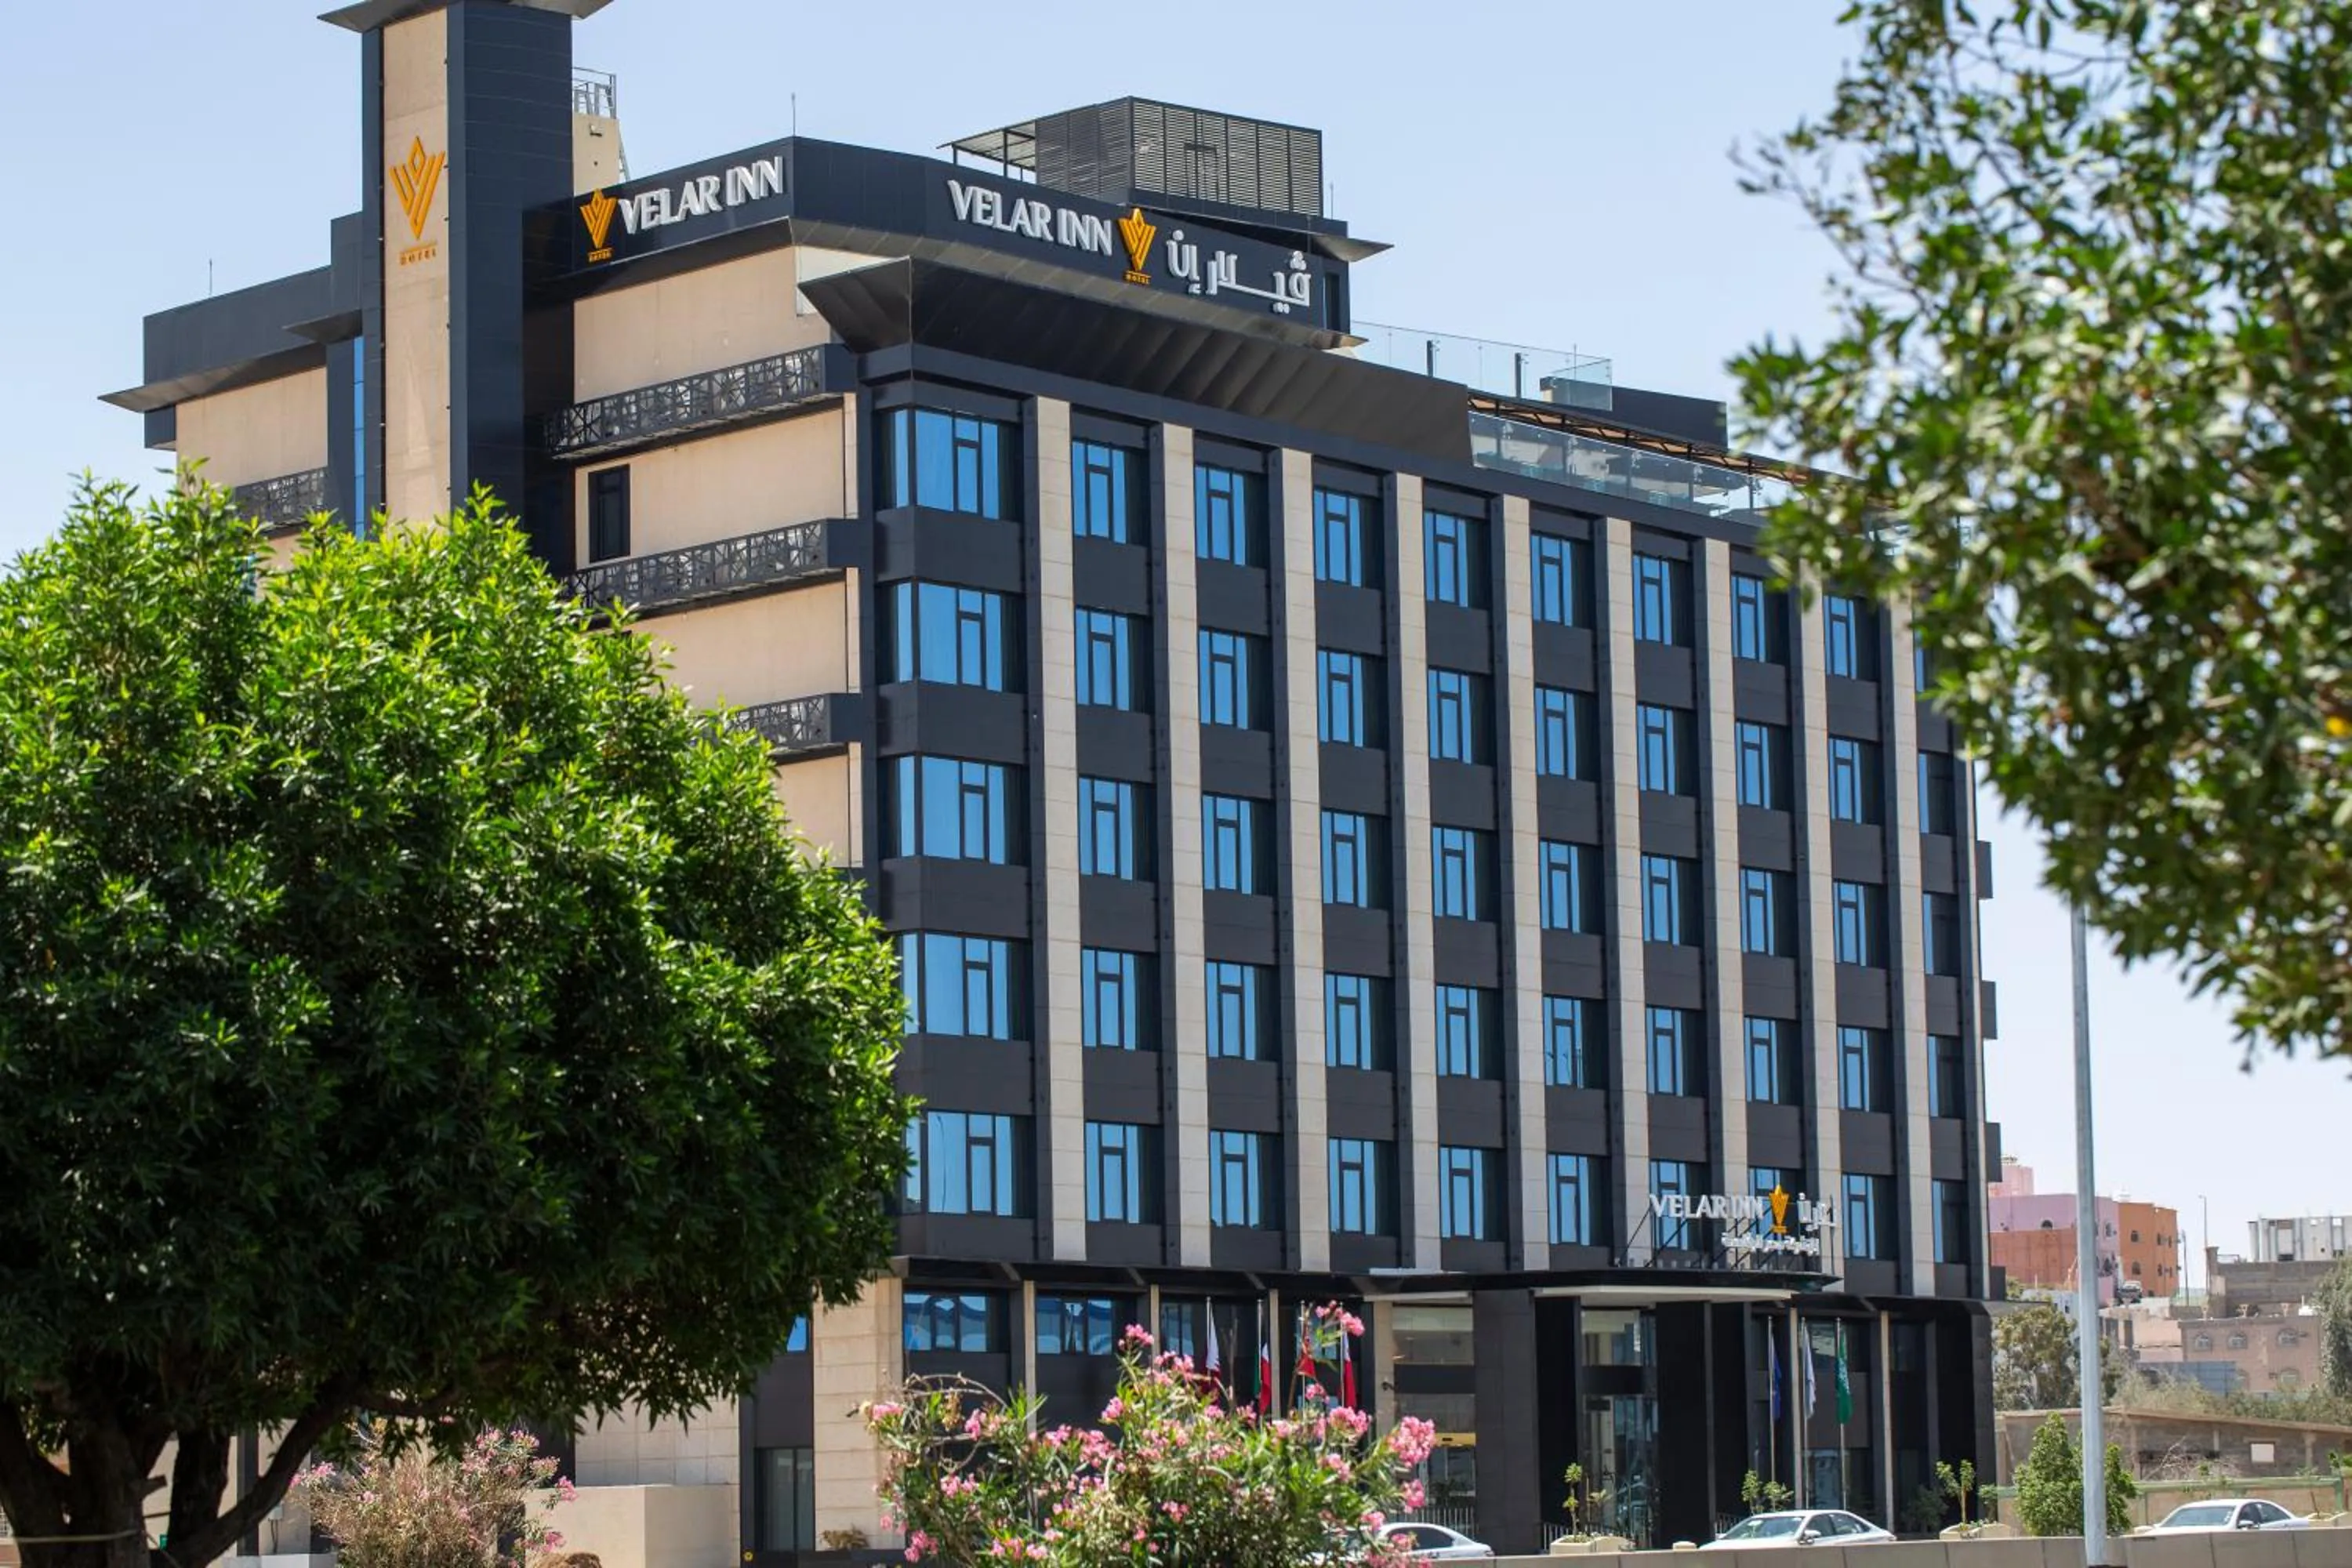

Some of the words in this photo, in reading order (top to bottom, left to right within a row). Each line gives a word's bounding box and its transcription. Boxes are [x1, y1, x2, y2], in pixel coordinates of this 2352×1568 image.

[617, 176, 723, 234] VELAR
[726, 156, 782, 206] INN
[947, 180, 1054, 241] VELAR
[1057, 208, 1112, 256] INN
[1650, 1194, 1727, 1218] VELAR
[1729, 1194, 1764, 1219] INN
